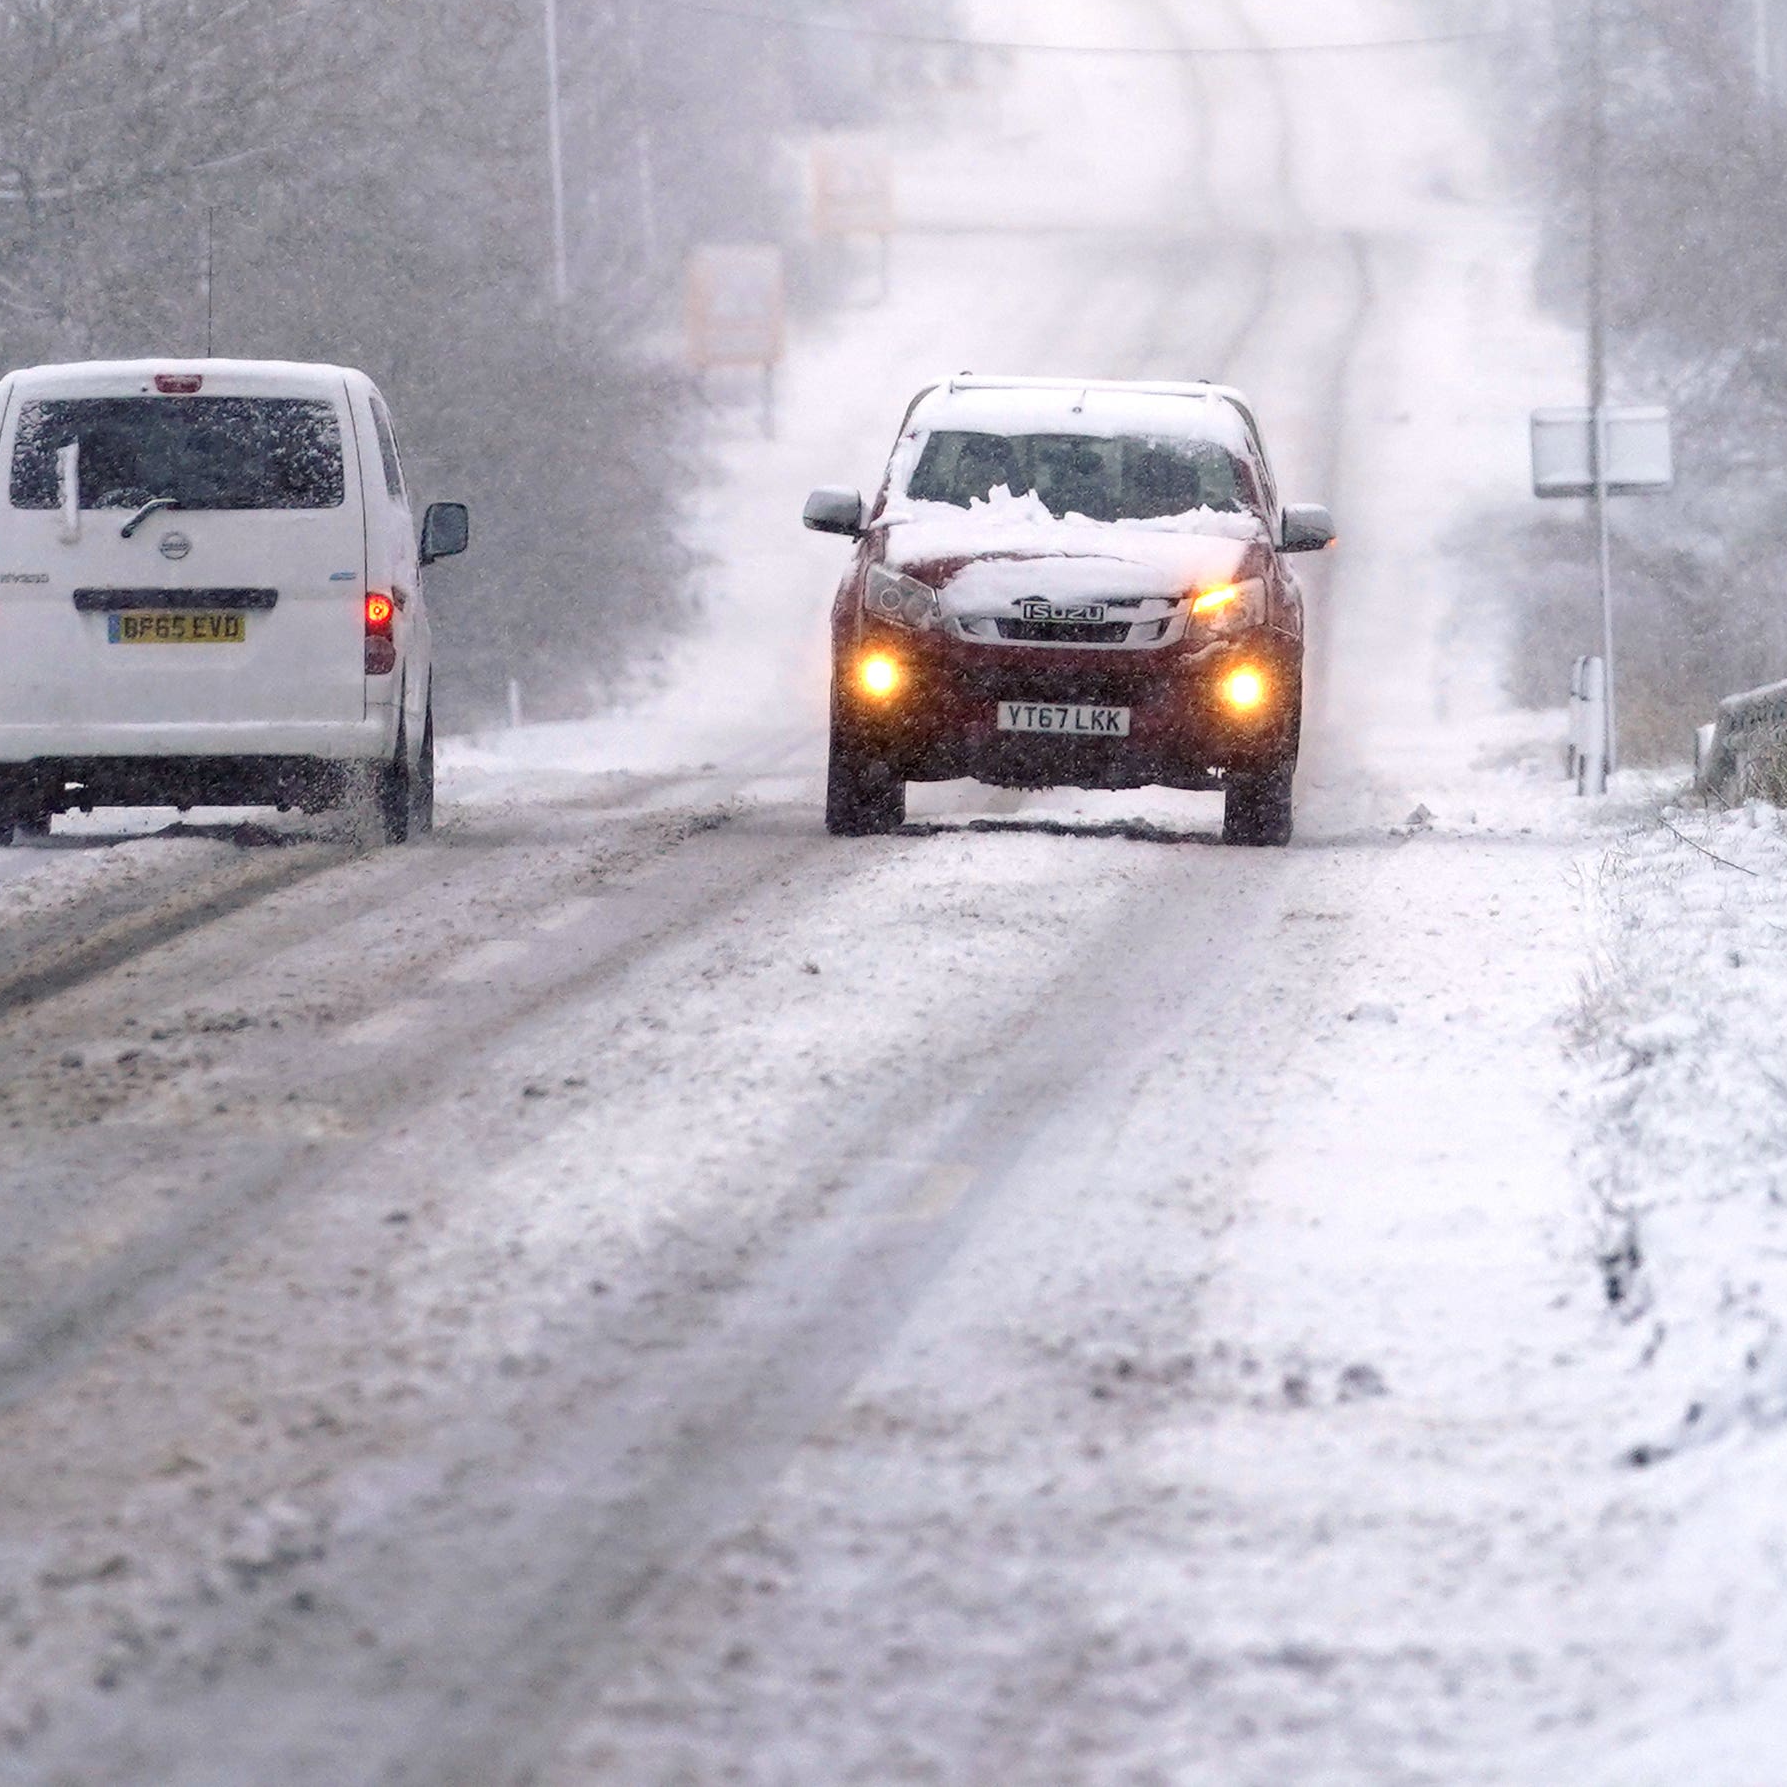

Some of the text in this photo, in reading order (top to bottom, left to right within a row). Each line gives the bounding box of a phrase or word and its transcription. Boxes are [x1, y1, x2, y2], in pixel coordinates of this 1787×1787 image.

[1023, 603, 1103, 621] ISUZU
[193, 614, 239, 638] EVD
[1008, 705, 1121, 732] YT67 LKK
